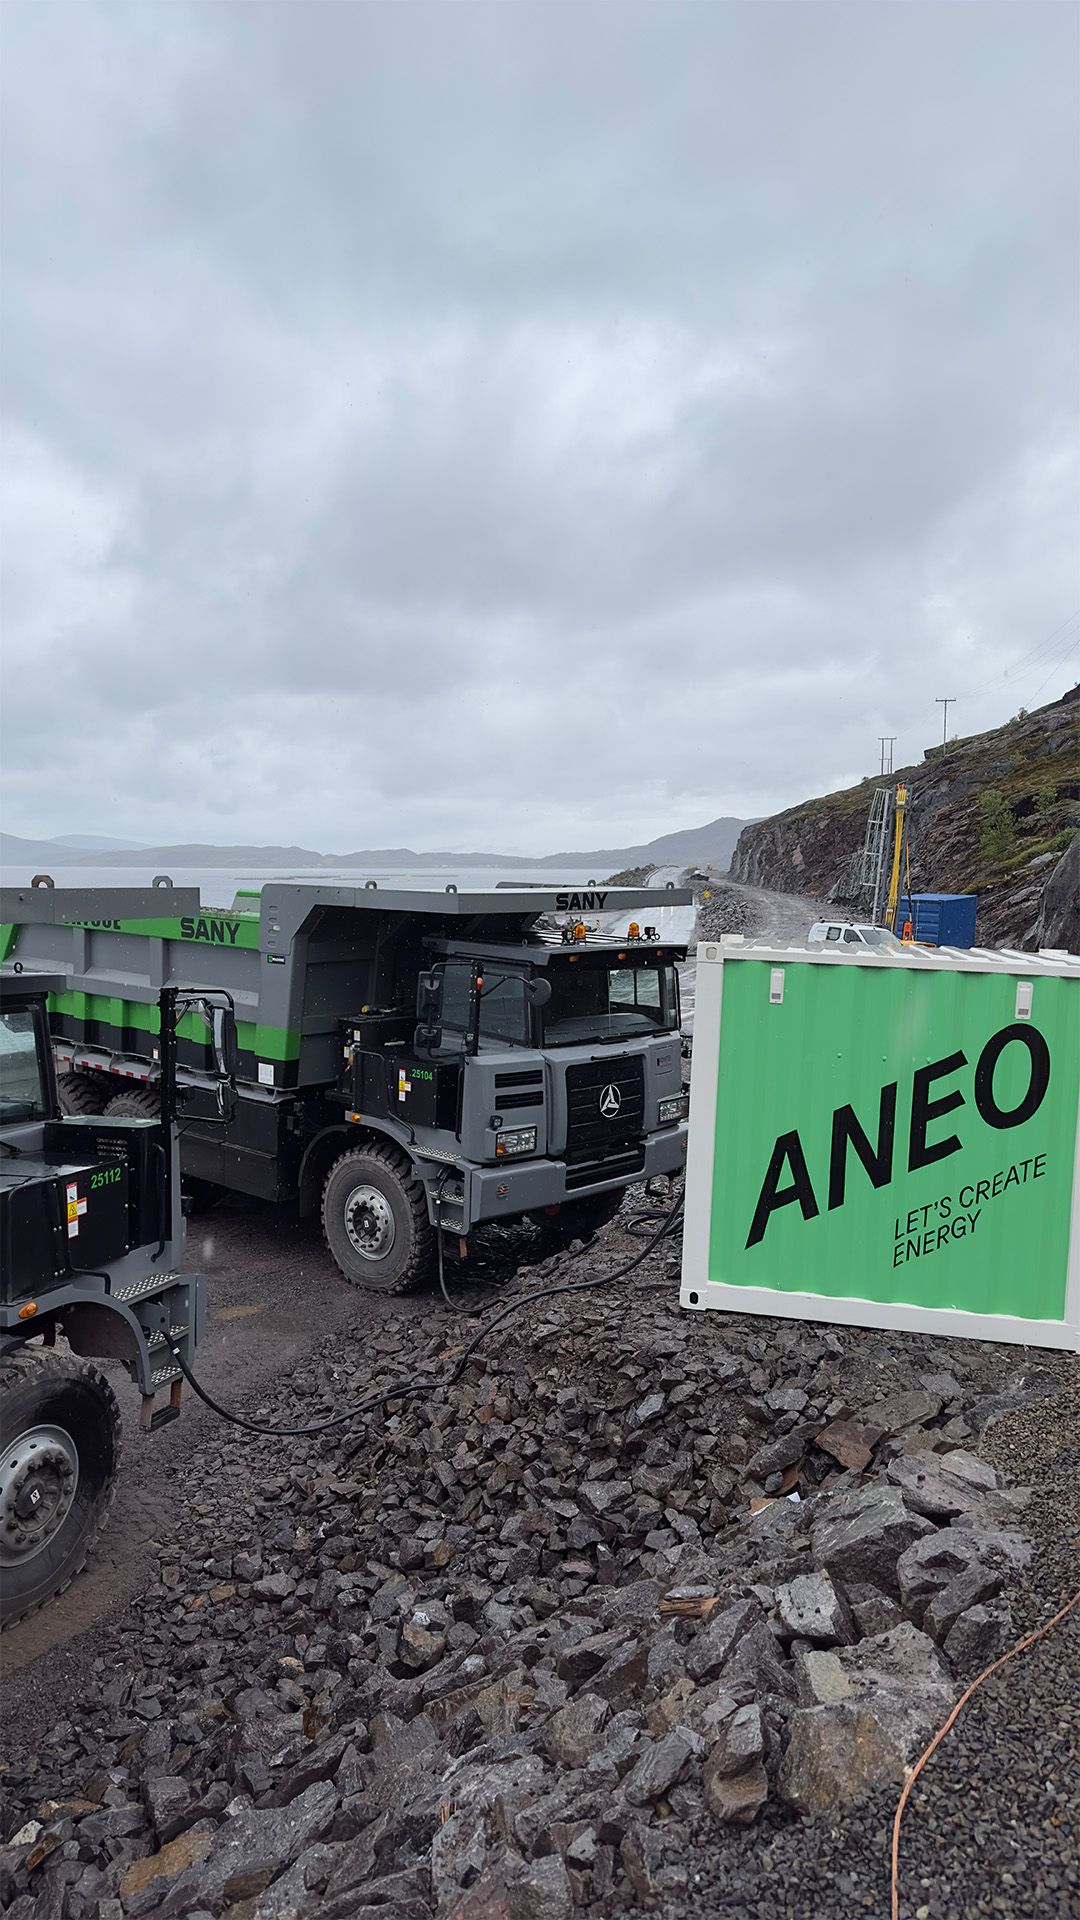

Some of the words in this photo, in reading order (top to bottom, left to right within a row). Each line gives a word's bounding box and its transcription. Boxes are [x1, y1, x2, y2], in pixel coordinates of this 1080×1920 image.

[555, 892, 608, 911] SANY
[180, 917, 240, 944] SANY
[744, 1023, 1051, 1250] ANEO
[91, 1167, 121, 1189] 25112
[895, 1196, 952, 1241] LET'S
[959, 1153, 1047, 1208] CREATE
[893, 1209, 982, 1268] ENERGY
